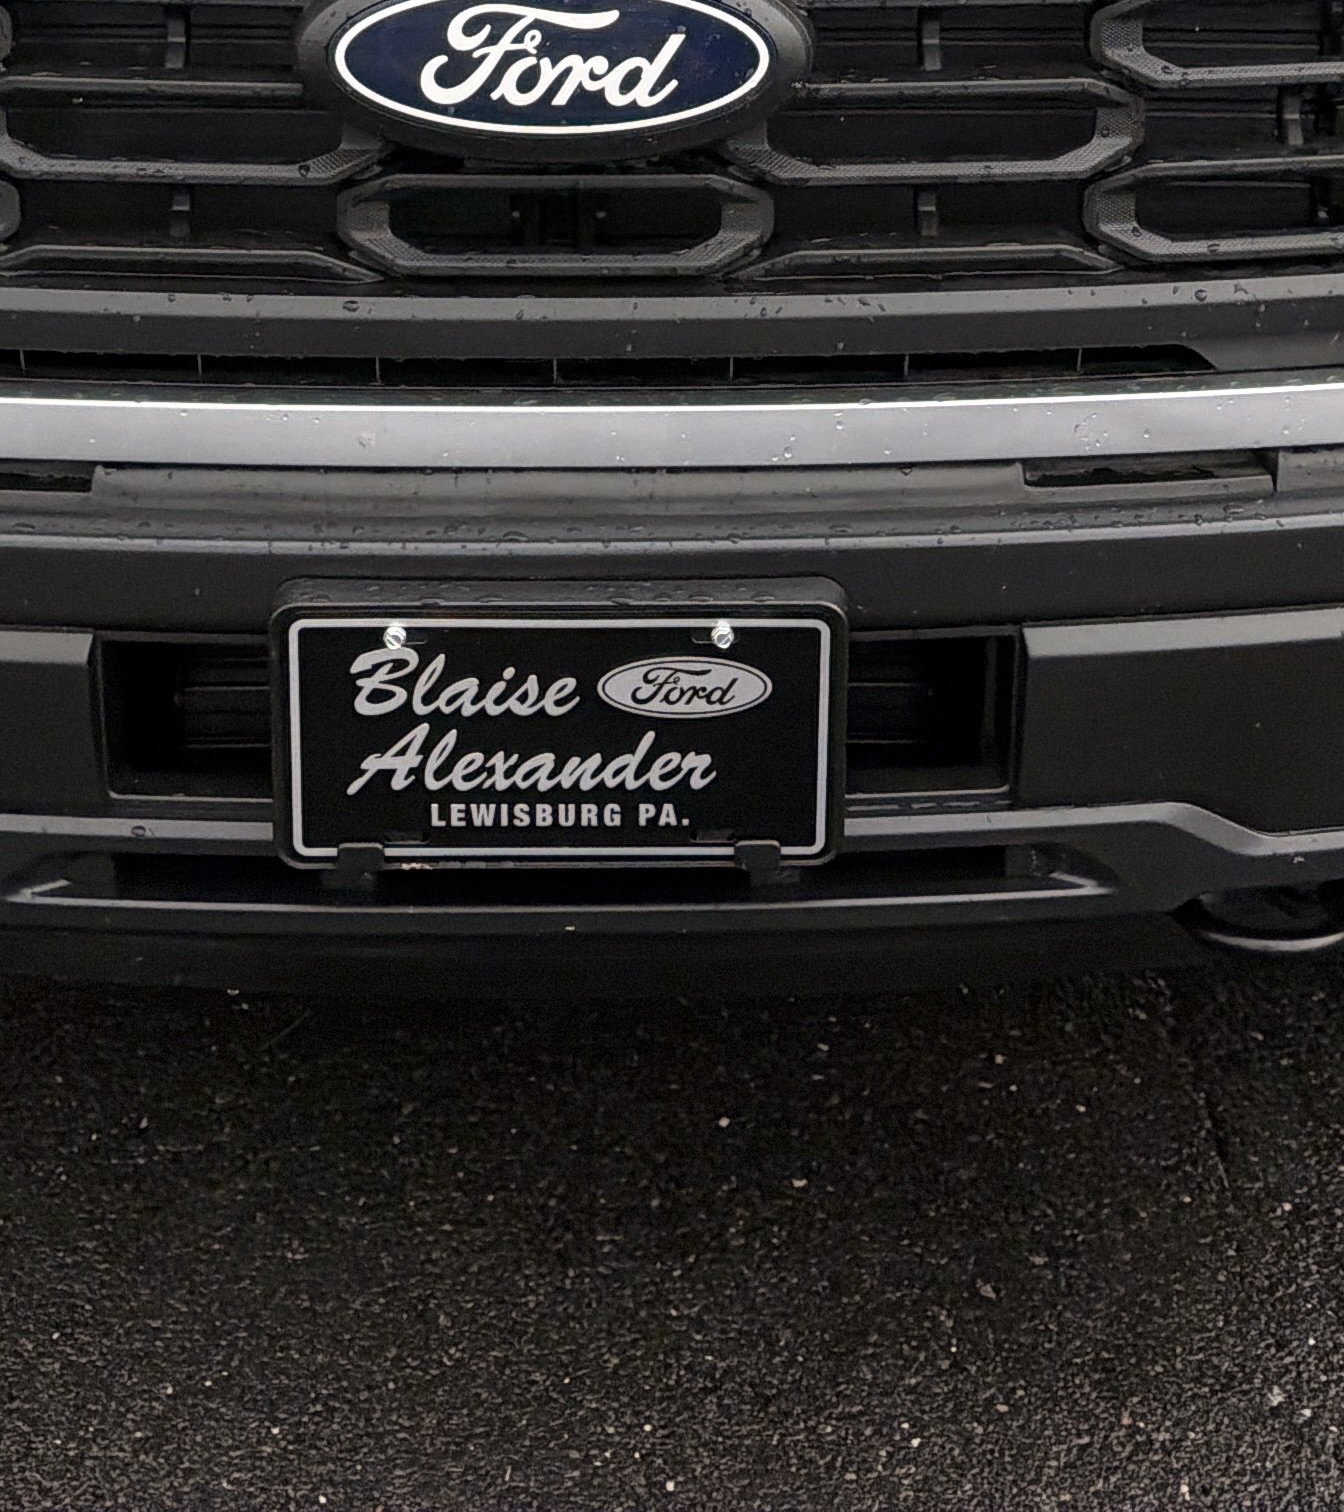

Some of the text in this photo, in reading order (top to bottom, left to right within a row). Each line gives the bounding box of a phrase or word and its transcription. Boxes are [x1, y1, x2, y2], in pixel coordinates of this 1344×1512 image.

[420, 3, 687, 108] Ford
[349, 646, 581, 717] Blaise
[630, 666, 739, 706] Ford
[346, 722, 717, 796] Alexander
[430, 803, 690, 828] LEWISBURG PA.
